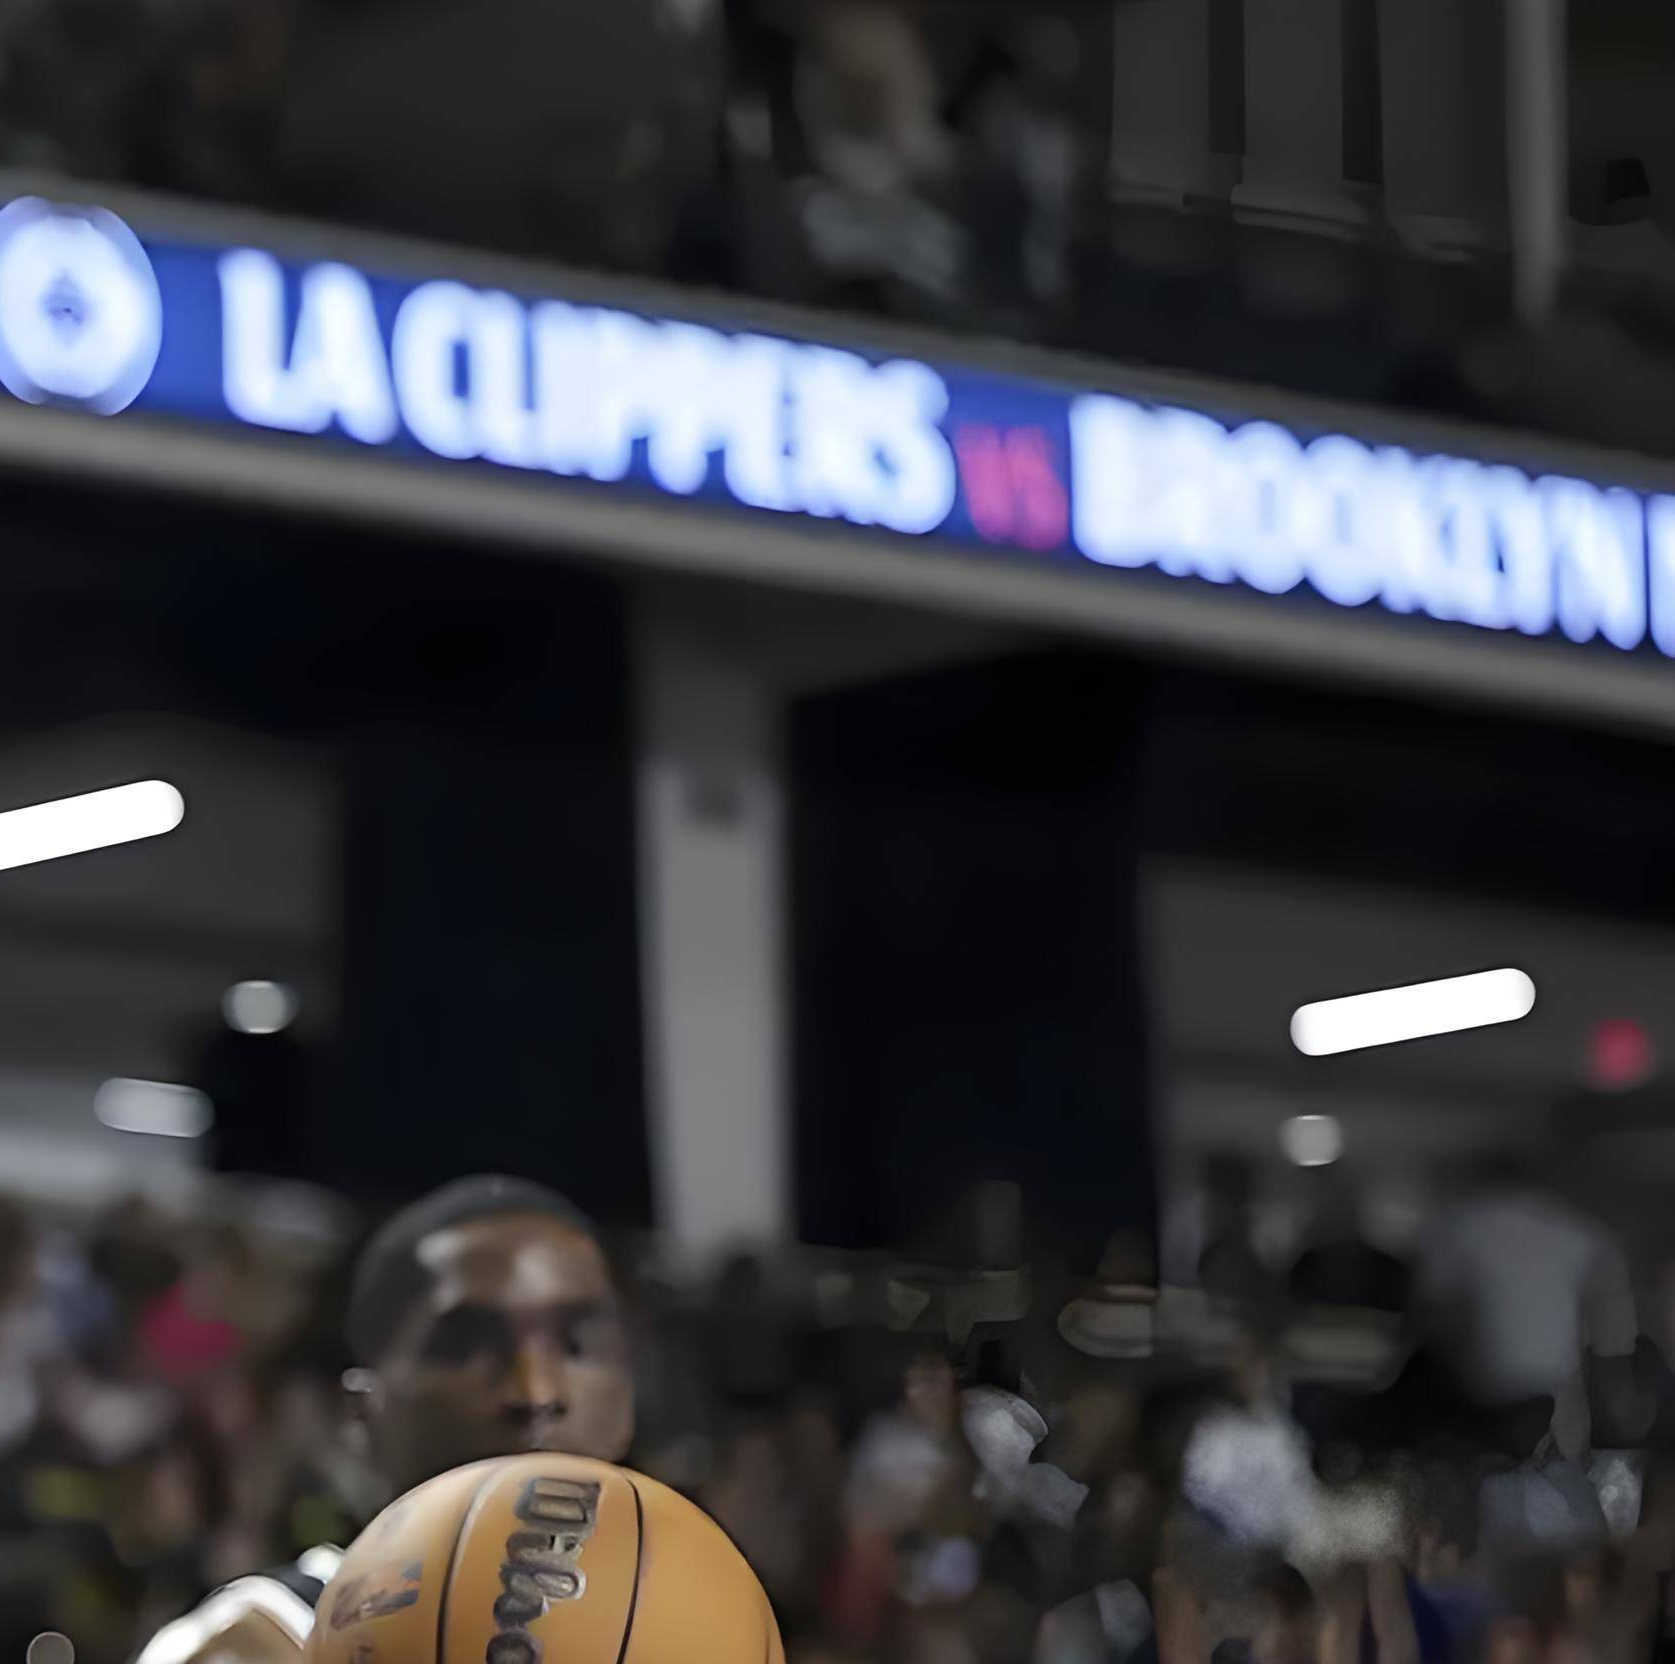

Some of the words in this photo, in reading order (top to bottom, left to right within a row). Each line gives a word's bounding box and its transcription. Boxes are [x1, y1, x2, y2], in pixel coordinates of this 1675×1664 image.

[217, 247, 398, 445] LA
[392, 280, 957, 534] CLIPPERS
[1070, 393, 1647, 651] BROOKLYN
